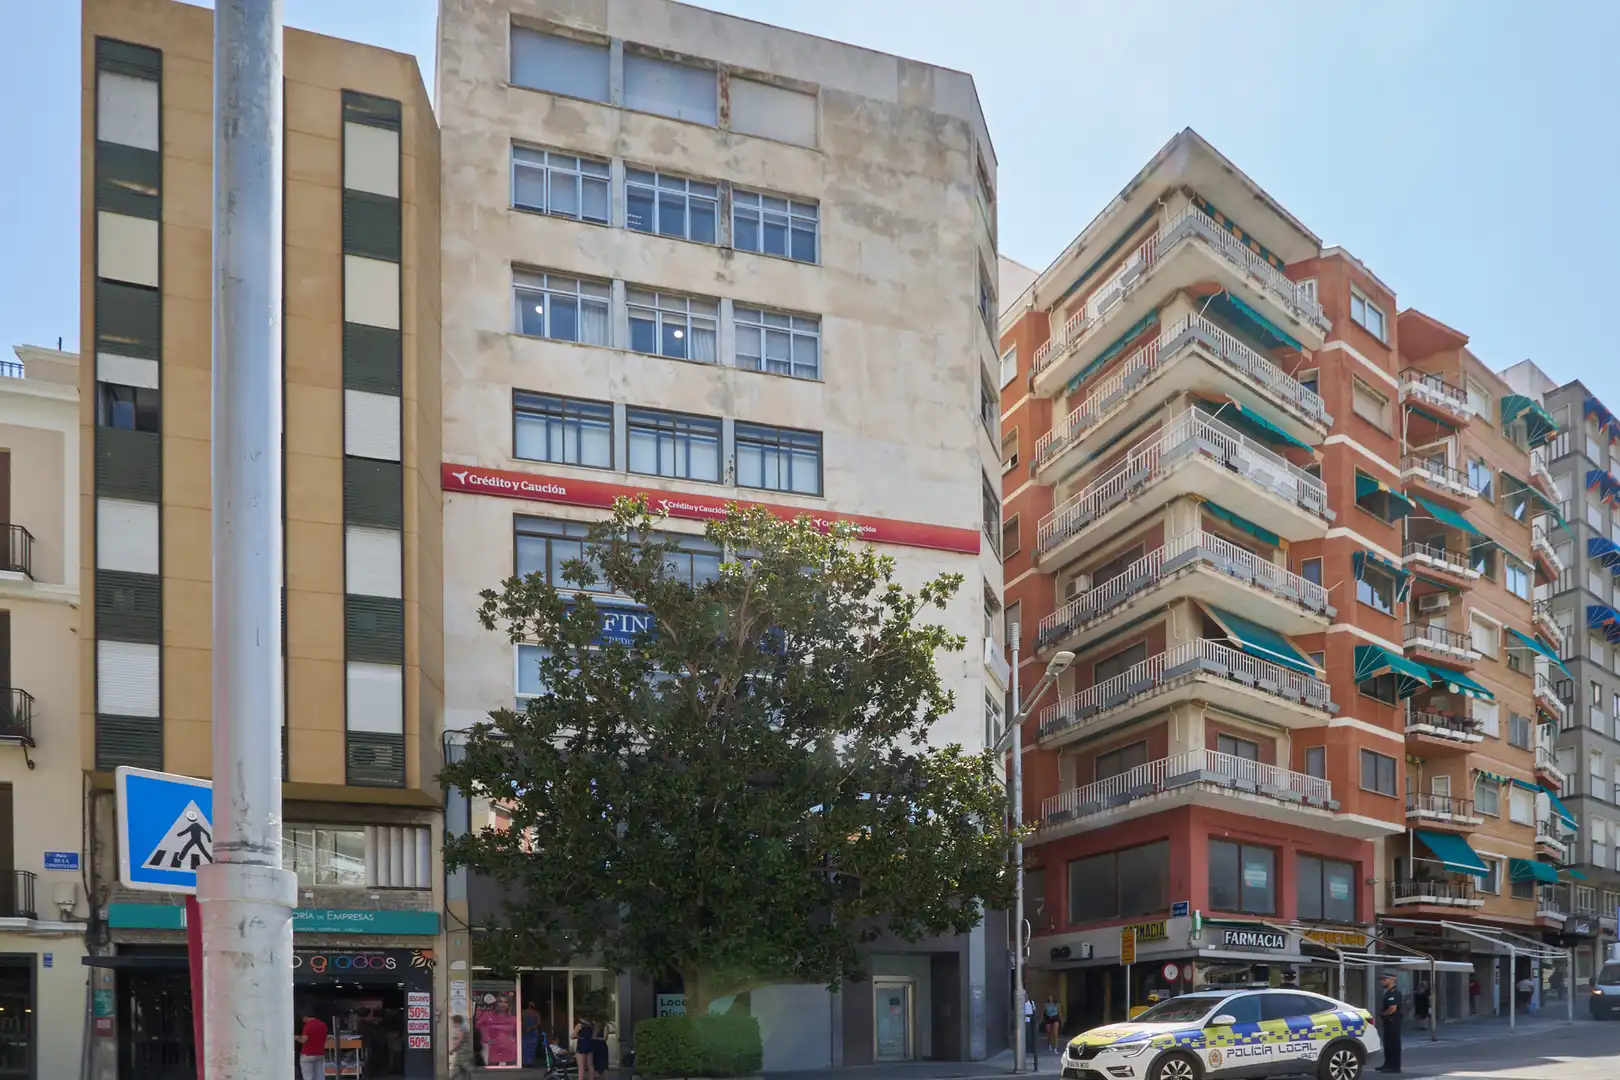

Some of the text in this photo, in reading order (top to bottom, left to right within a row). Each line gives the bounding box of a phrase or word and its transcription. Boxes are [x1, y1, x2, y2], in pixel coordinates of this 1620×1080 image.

[469, 474, 567, 495] Crédito y Caución
[668, 501, 694, 511] Crédito
[326, 910, 374, 921] EMPRESAS
[1224, 931, 1284, 948] FARMACIA
[409, 1006, 430, 1019] 50%
[409, 1036, 430, 1048] 50%
[1278, 1042, 1317, 1053] LOCAL
